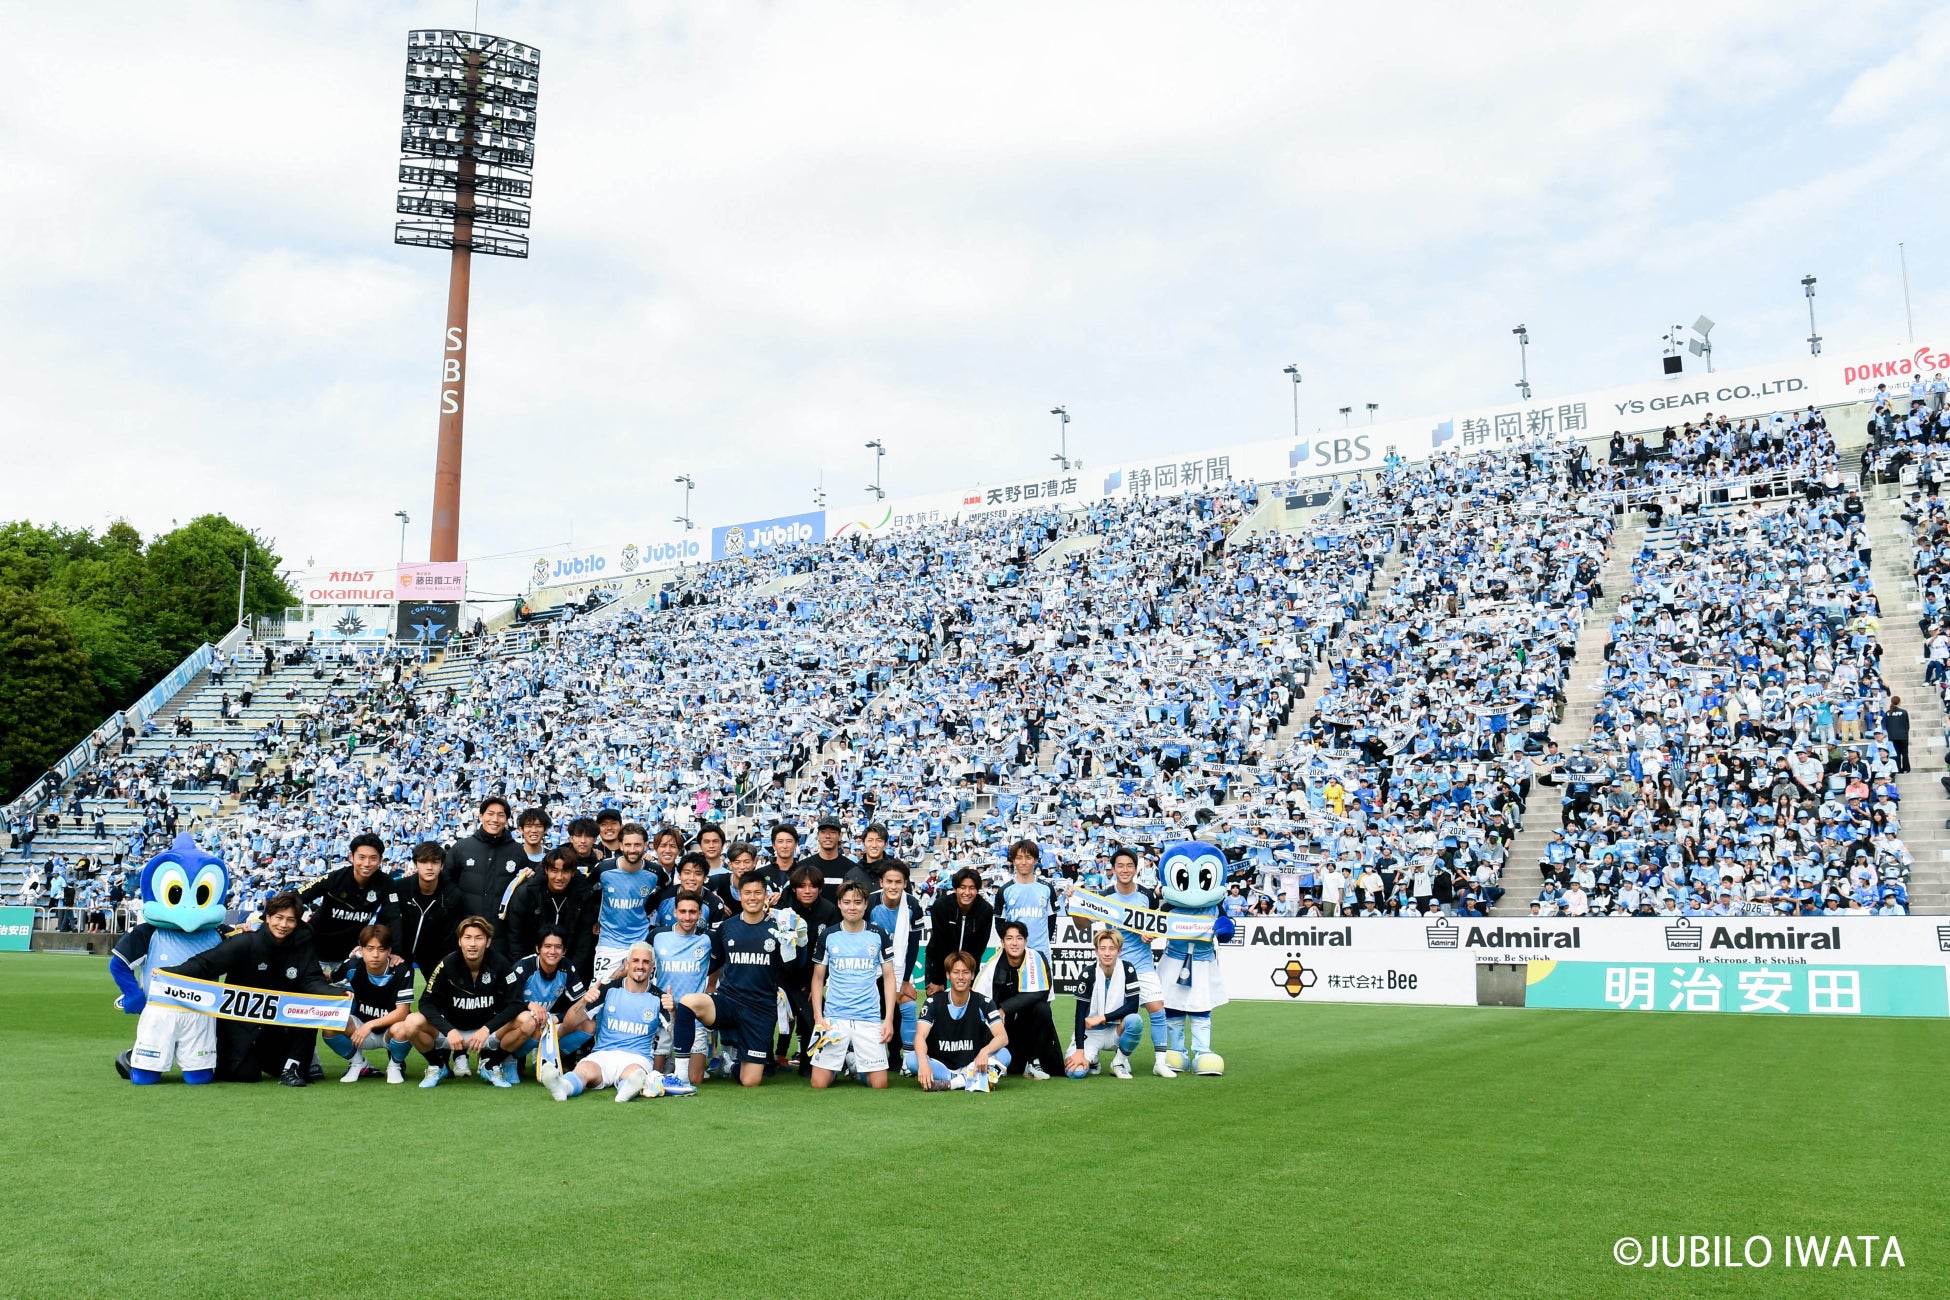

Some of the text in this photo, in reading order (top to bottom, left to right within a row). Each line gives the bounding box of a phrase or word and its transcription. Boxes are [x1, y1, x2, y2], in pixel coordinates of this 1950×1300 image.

[442, 327, 462, 414] SBS
[1614, 377, 1809, 416] Y'S GEAR CO.,LTD.
[1462, 402, 1587, 446] 静岡新聞
[1315, 435, 1371, 467] SBS
[1128, 455, 1231, 494] 静岡新聞
[987, 477, 1077, 505] 天野回漕店
[895, 510, 939, 526] 日本旅行
[329, 571, 374, 582] オカムラ
[411, 606, 447, 615] CONTINUE
[1450, 827, 1466, 835] 2026
[1255, 840, 1269, 848] 2026
[332, 908, 372, 922] YAMAHA
[1009, 907, 1043, 918] YAMAHA
[1741, 902, 1762, 913] 2026
[1123, 908, 1167, 934] 2026
[1250, 926, 1351, 946] Admiral
[1465, 926, 1580, 948] Admiral
[1671, 926, 1841, 950] Admiral Admiral
[660, 961, 700, 972] YAMAHA
[728, 952, 770, 965] YAMAHA
[833, 958, 874, 969] YAMAHA
[1754, 956, 1768, 964] Be
[1328, 970, 1417, 989] 株式会社 Bee
[1605, 967, 1861, 1013] 明治安田
[219, 988, 279, 1020] 2026
[453, 996, 494, 1010] YAMAHA
[608, 1018, 649, 1035] YAMAHA
[938, 1039, 973, 1052] YAMAHA
